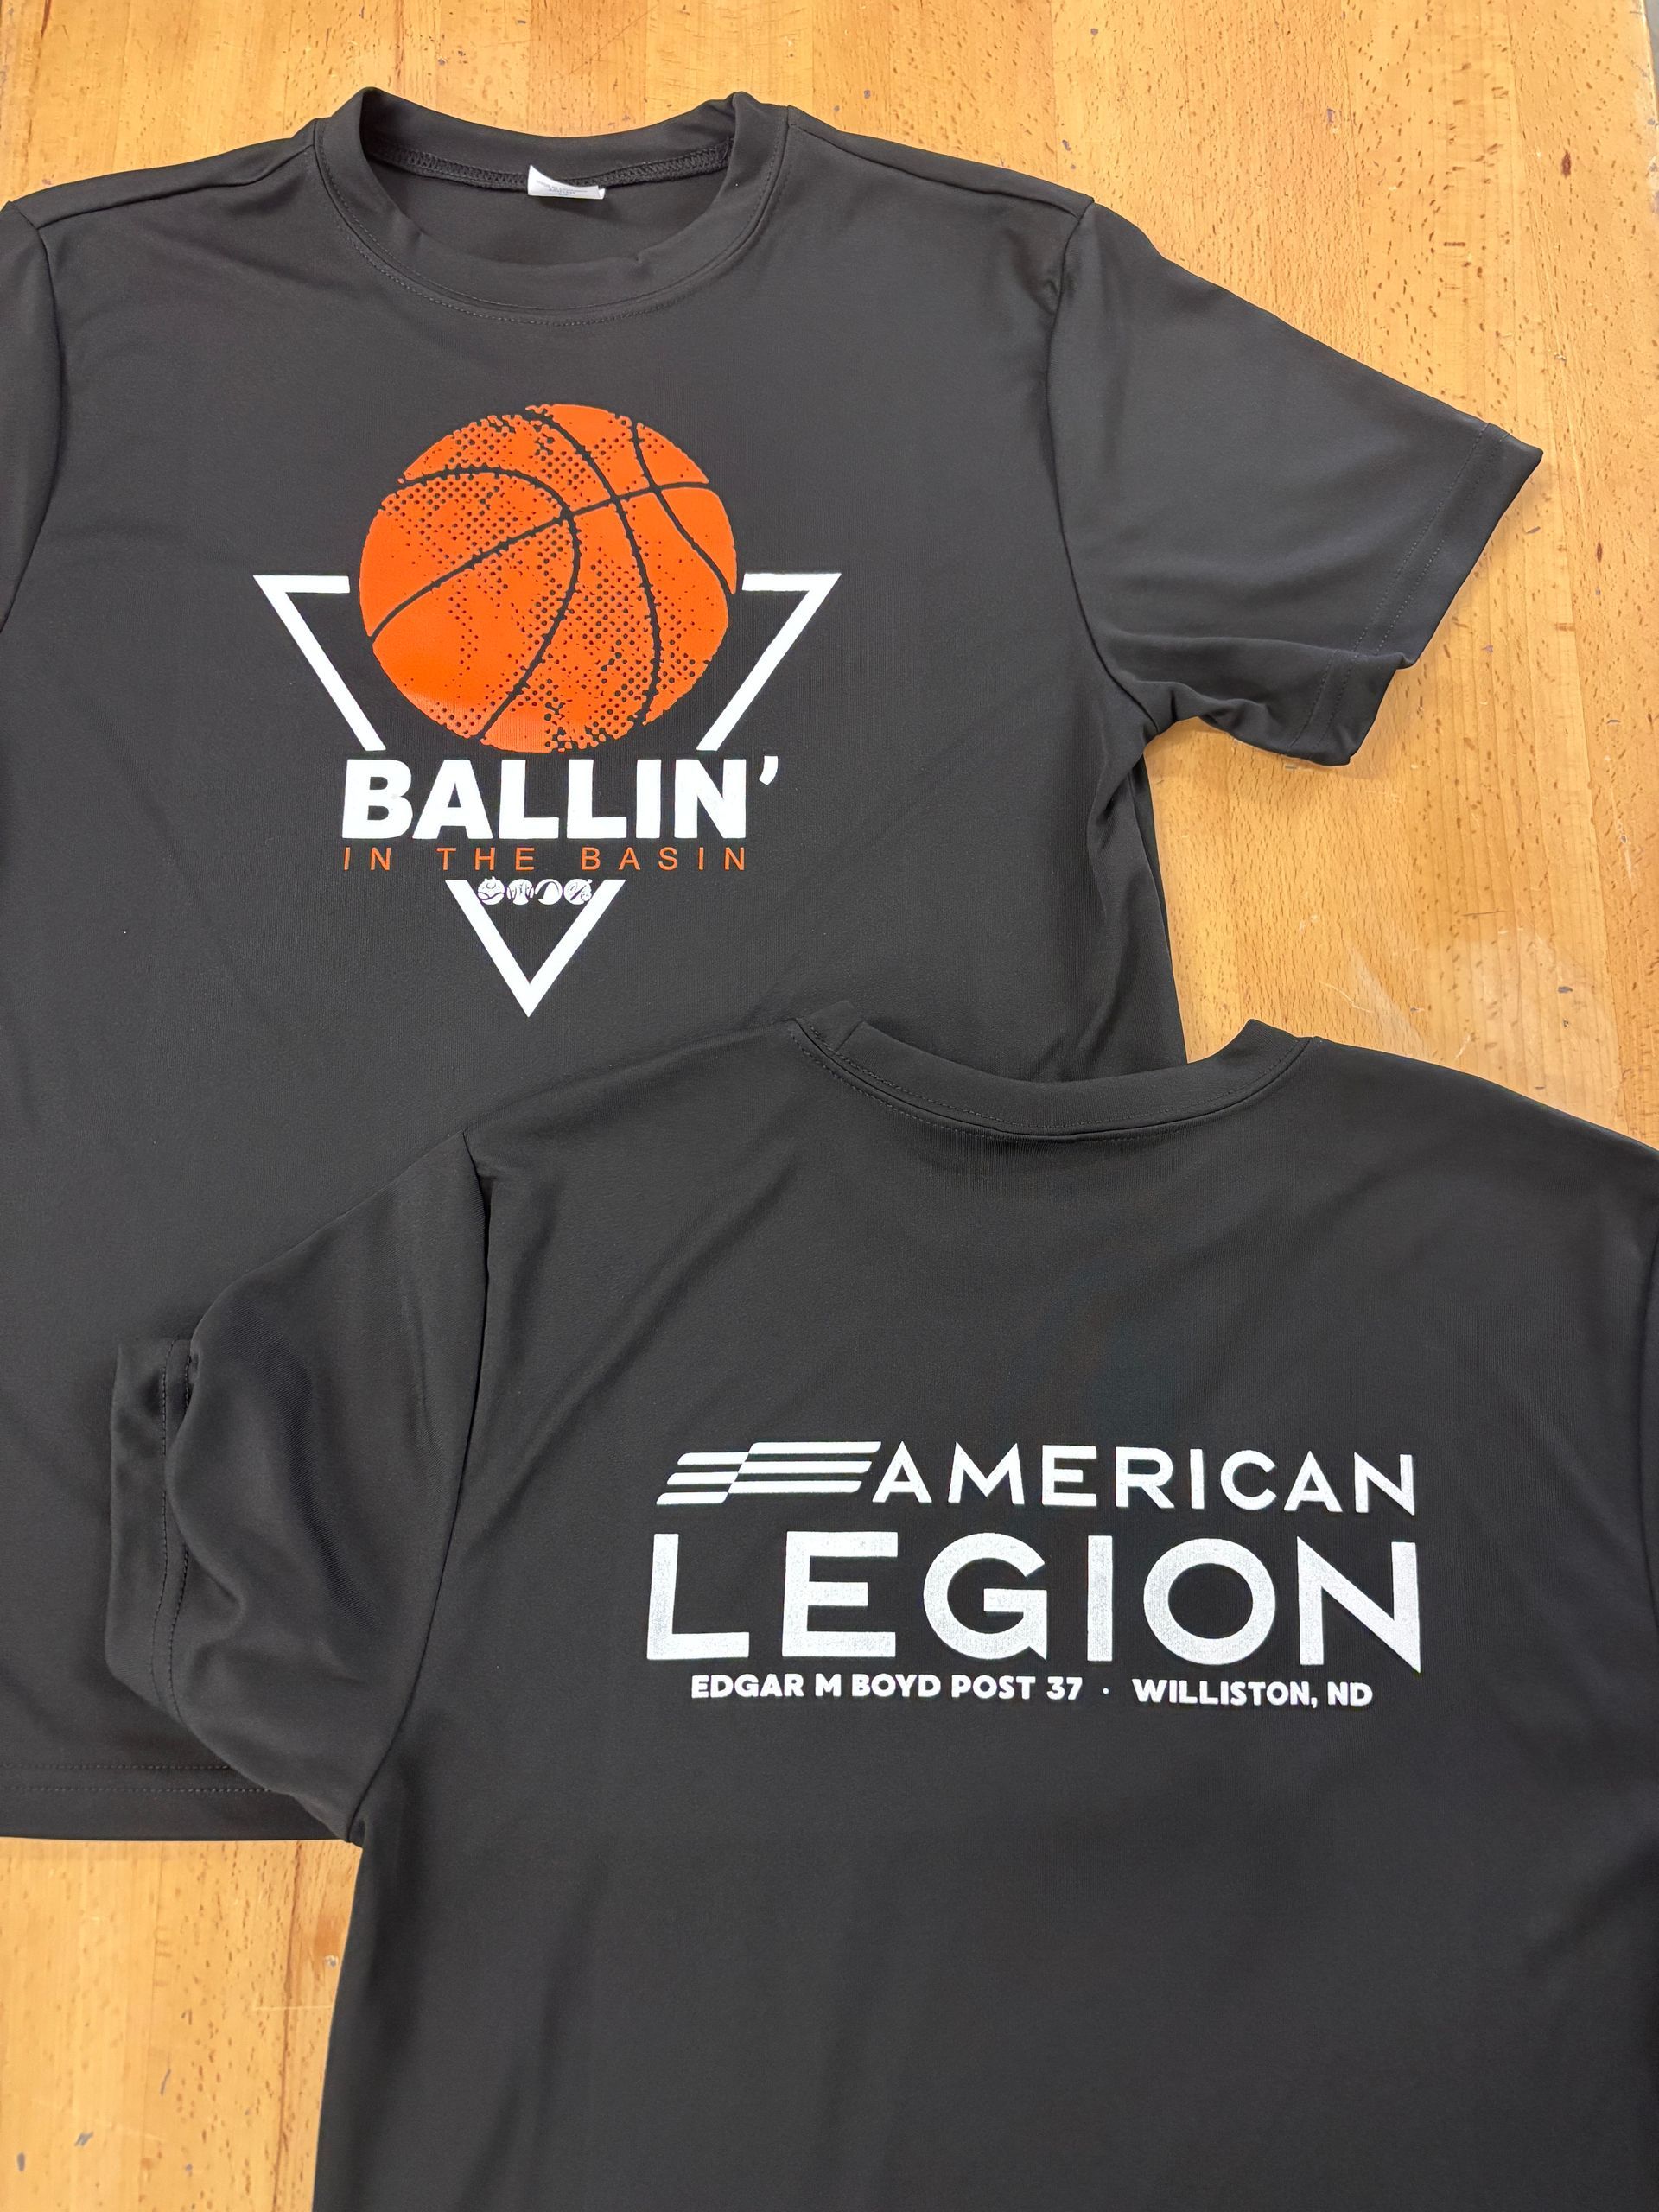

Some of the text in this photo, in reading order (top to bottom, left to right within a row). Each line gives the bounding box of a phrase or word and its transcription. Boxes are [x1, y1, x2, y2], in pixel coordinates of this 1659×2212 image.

[343, 847, 745, 871] IN THE BASIN
[872, 1440, 1415, 1516] AMERICAN
[646, 1530, 1421, 1674] LEGION
[690, 1673, 1373, 1709] EDGAR M BOYD POST 37 WILLISTON, ND
